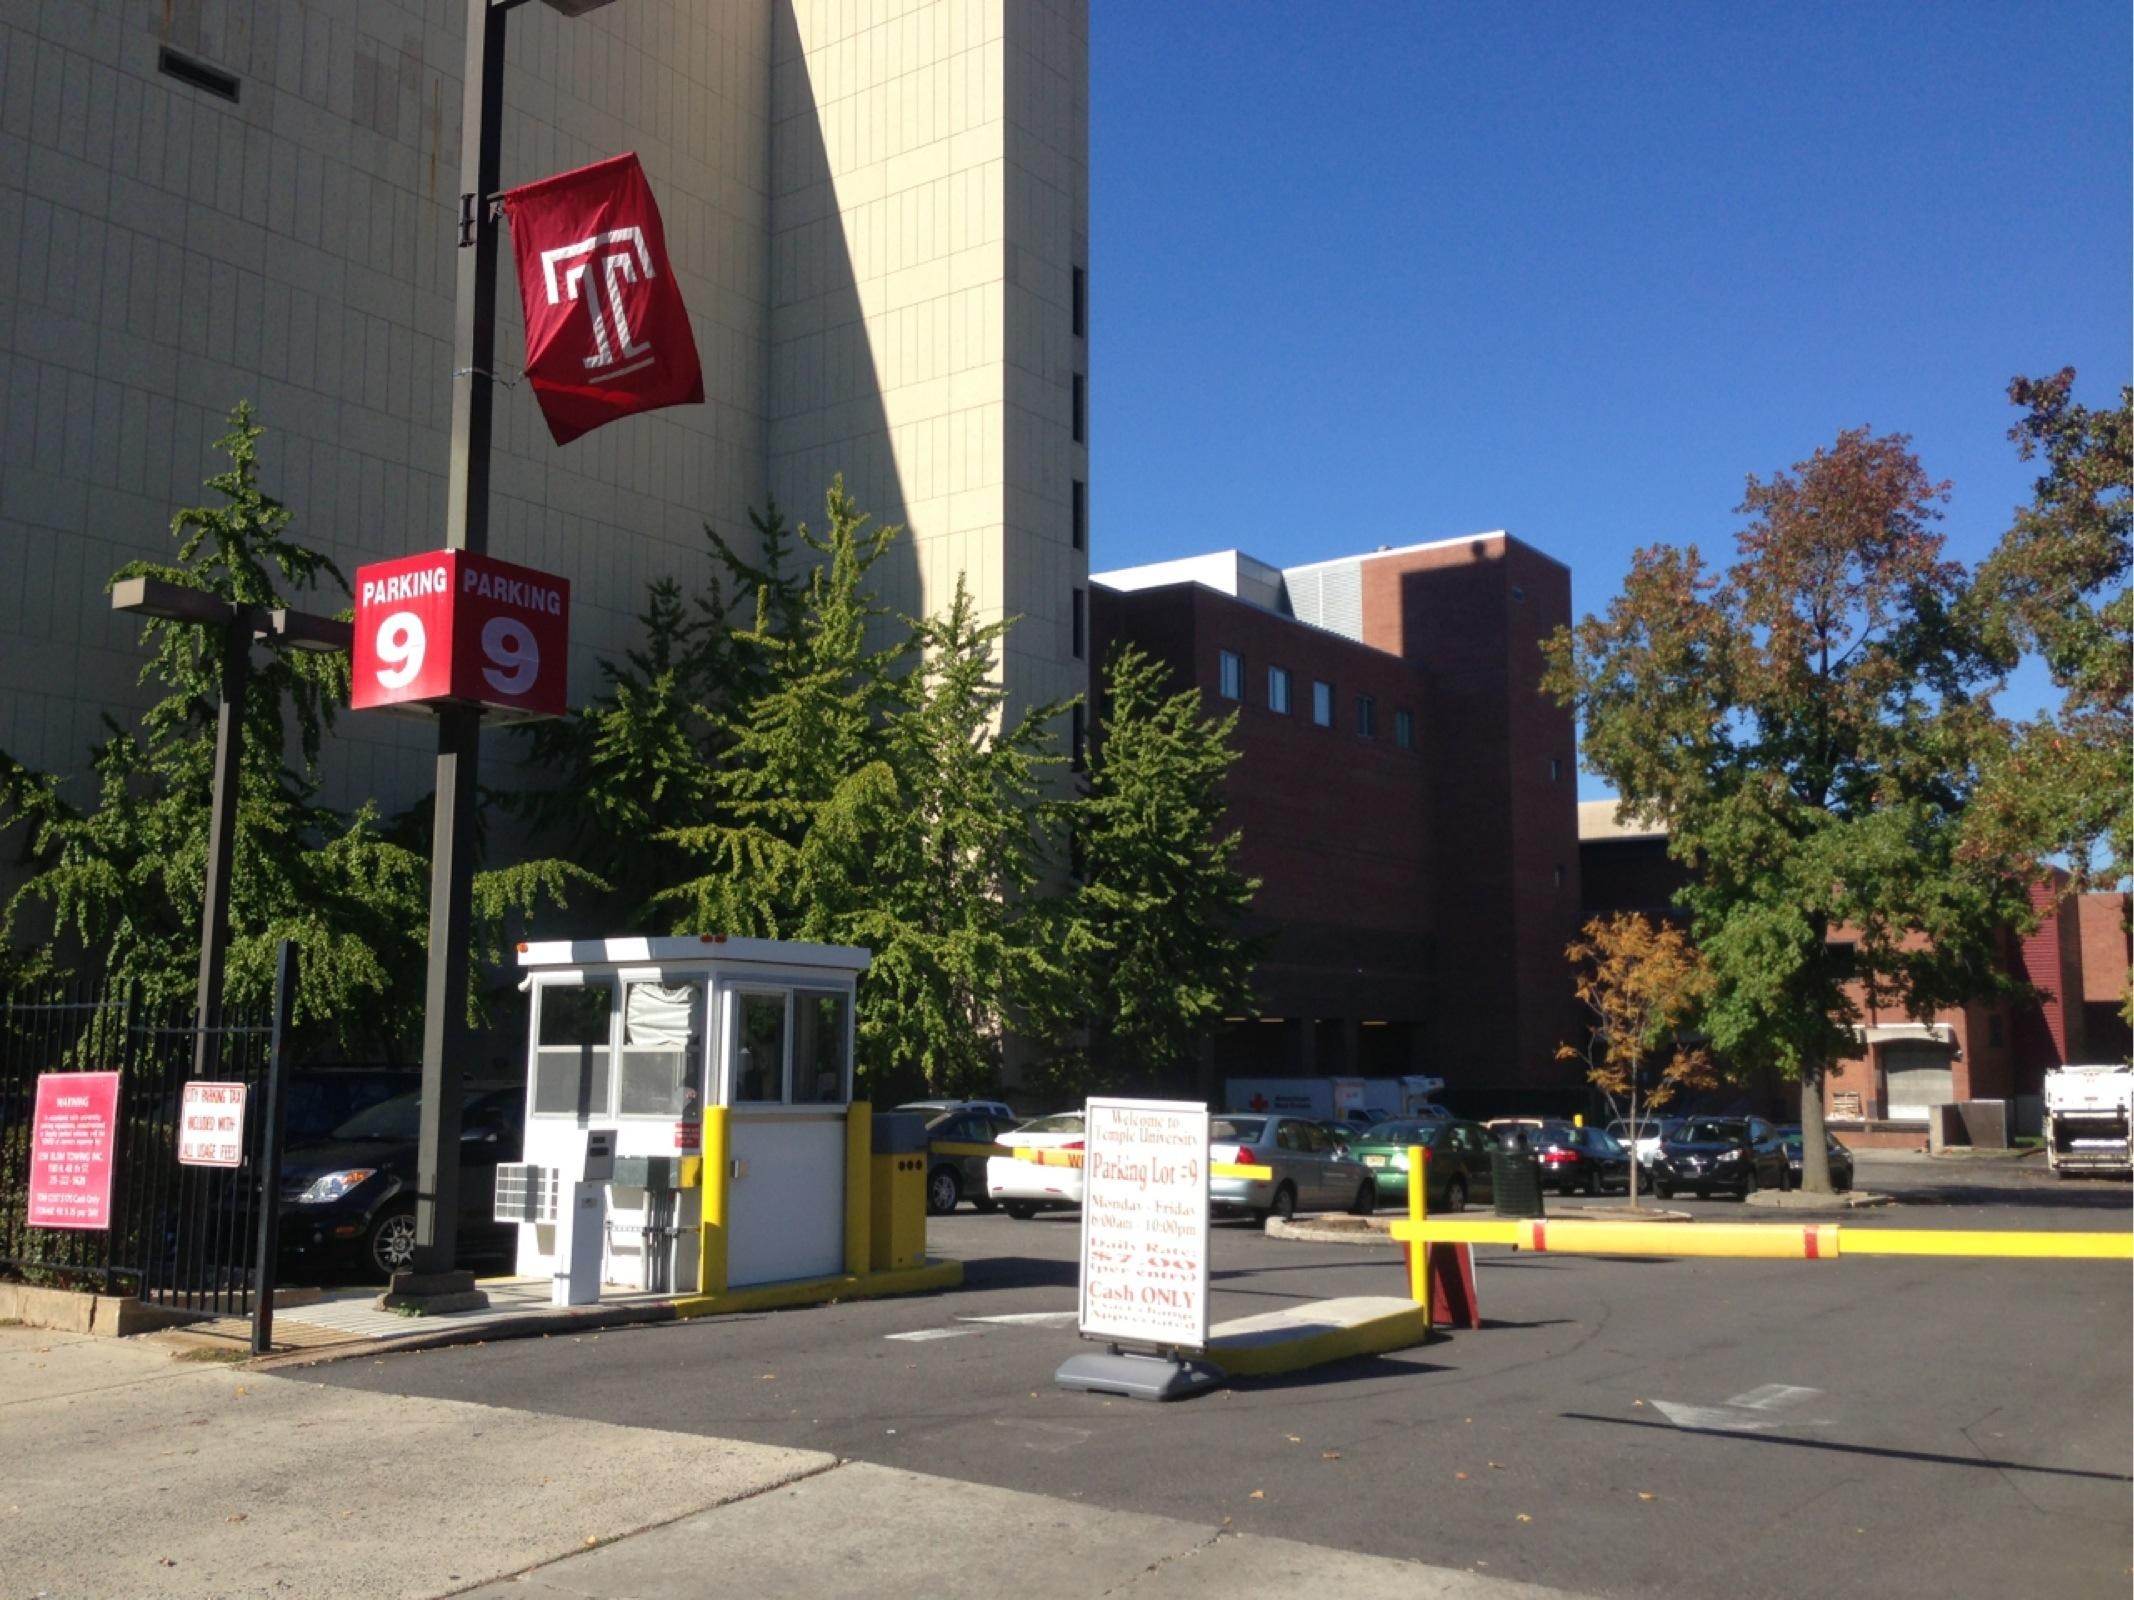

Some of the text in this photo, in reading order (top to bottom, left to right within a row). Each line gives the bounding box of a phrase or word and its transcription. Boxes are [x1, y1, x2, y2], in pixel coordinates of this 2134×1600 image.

[362, 566, 448, 608] PARKING
[463, 567, 561, 615] PARKING
[375, 611, 426, 689] 9
[481, 616, 539, 696] 9
[1094, 1125, 1198, 1146] Temple University
[1111, 1108, 1181, 1129] Welcome to
[1092, 1152, 1148, 1191] Parking
[1151, 1156, 1176, 1185] Lot
[1091, 1194, 1142, 1212] Monday
[1155, 1199, 1196, 1217] Friday
[1146, 1219, 1197, 1238] 10:00pm
[1088, 1279, 1196, 1309] Cash ONLY
